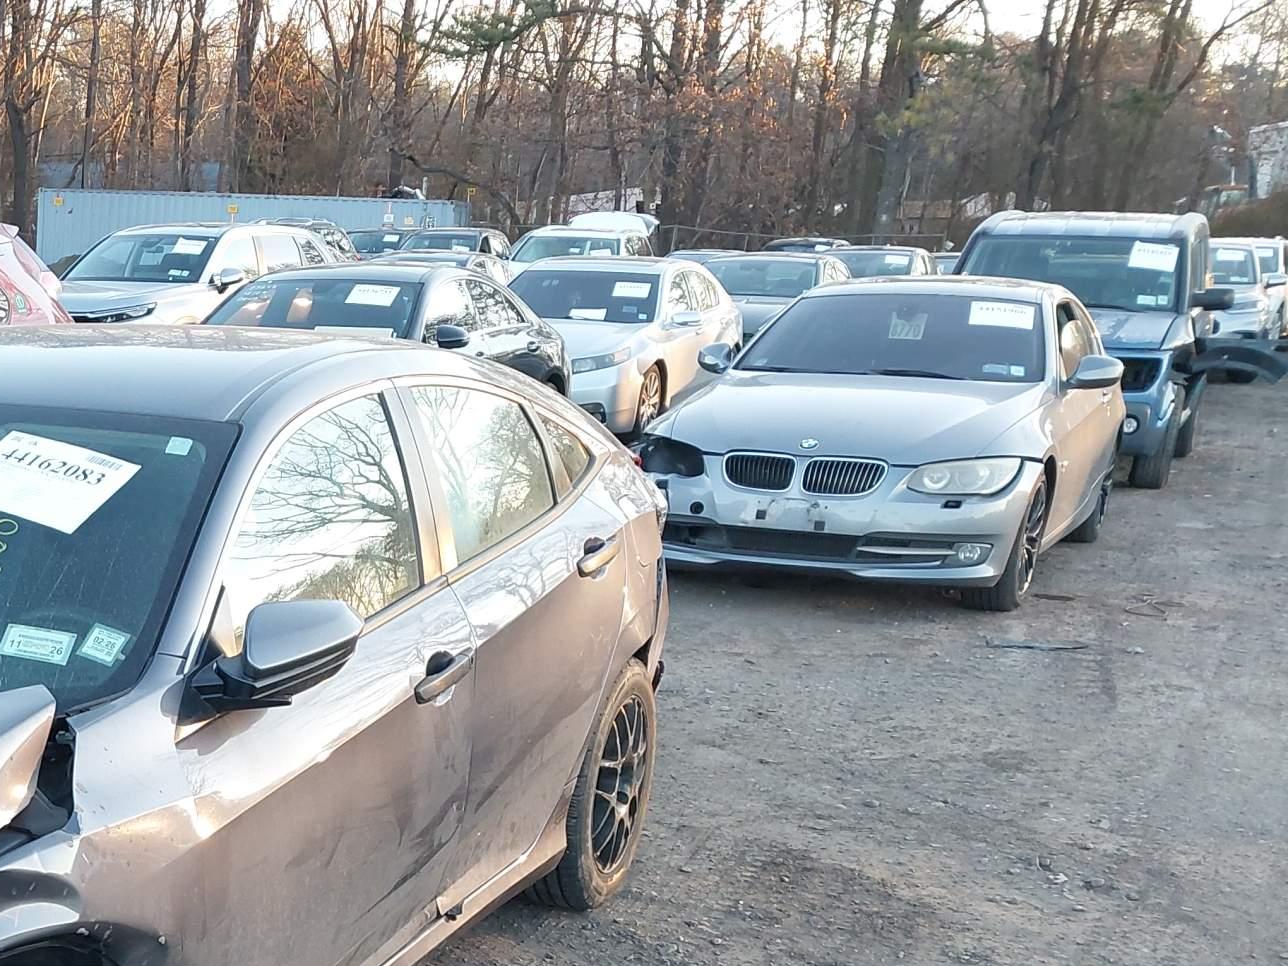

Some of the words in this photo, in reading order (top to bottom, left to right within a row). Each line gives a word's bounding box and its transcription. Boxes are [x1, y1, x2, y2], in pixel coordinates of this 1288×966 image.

[1, 448, 107, 486] 44162083
[9, 638, 22, 649] 11
[49, 645, 64, 656] 26
